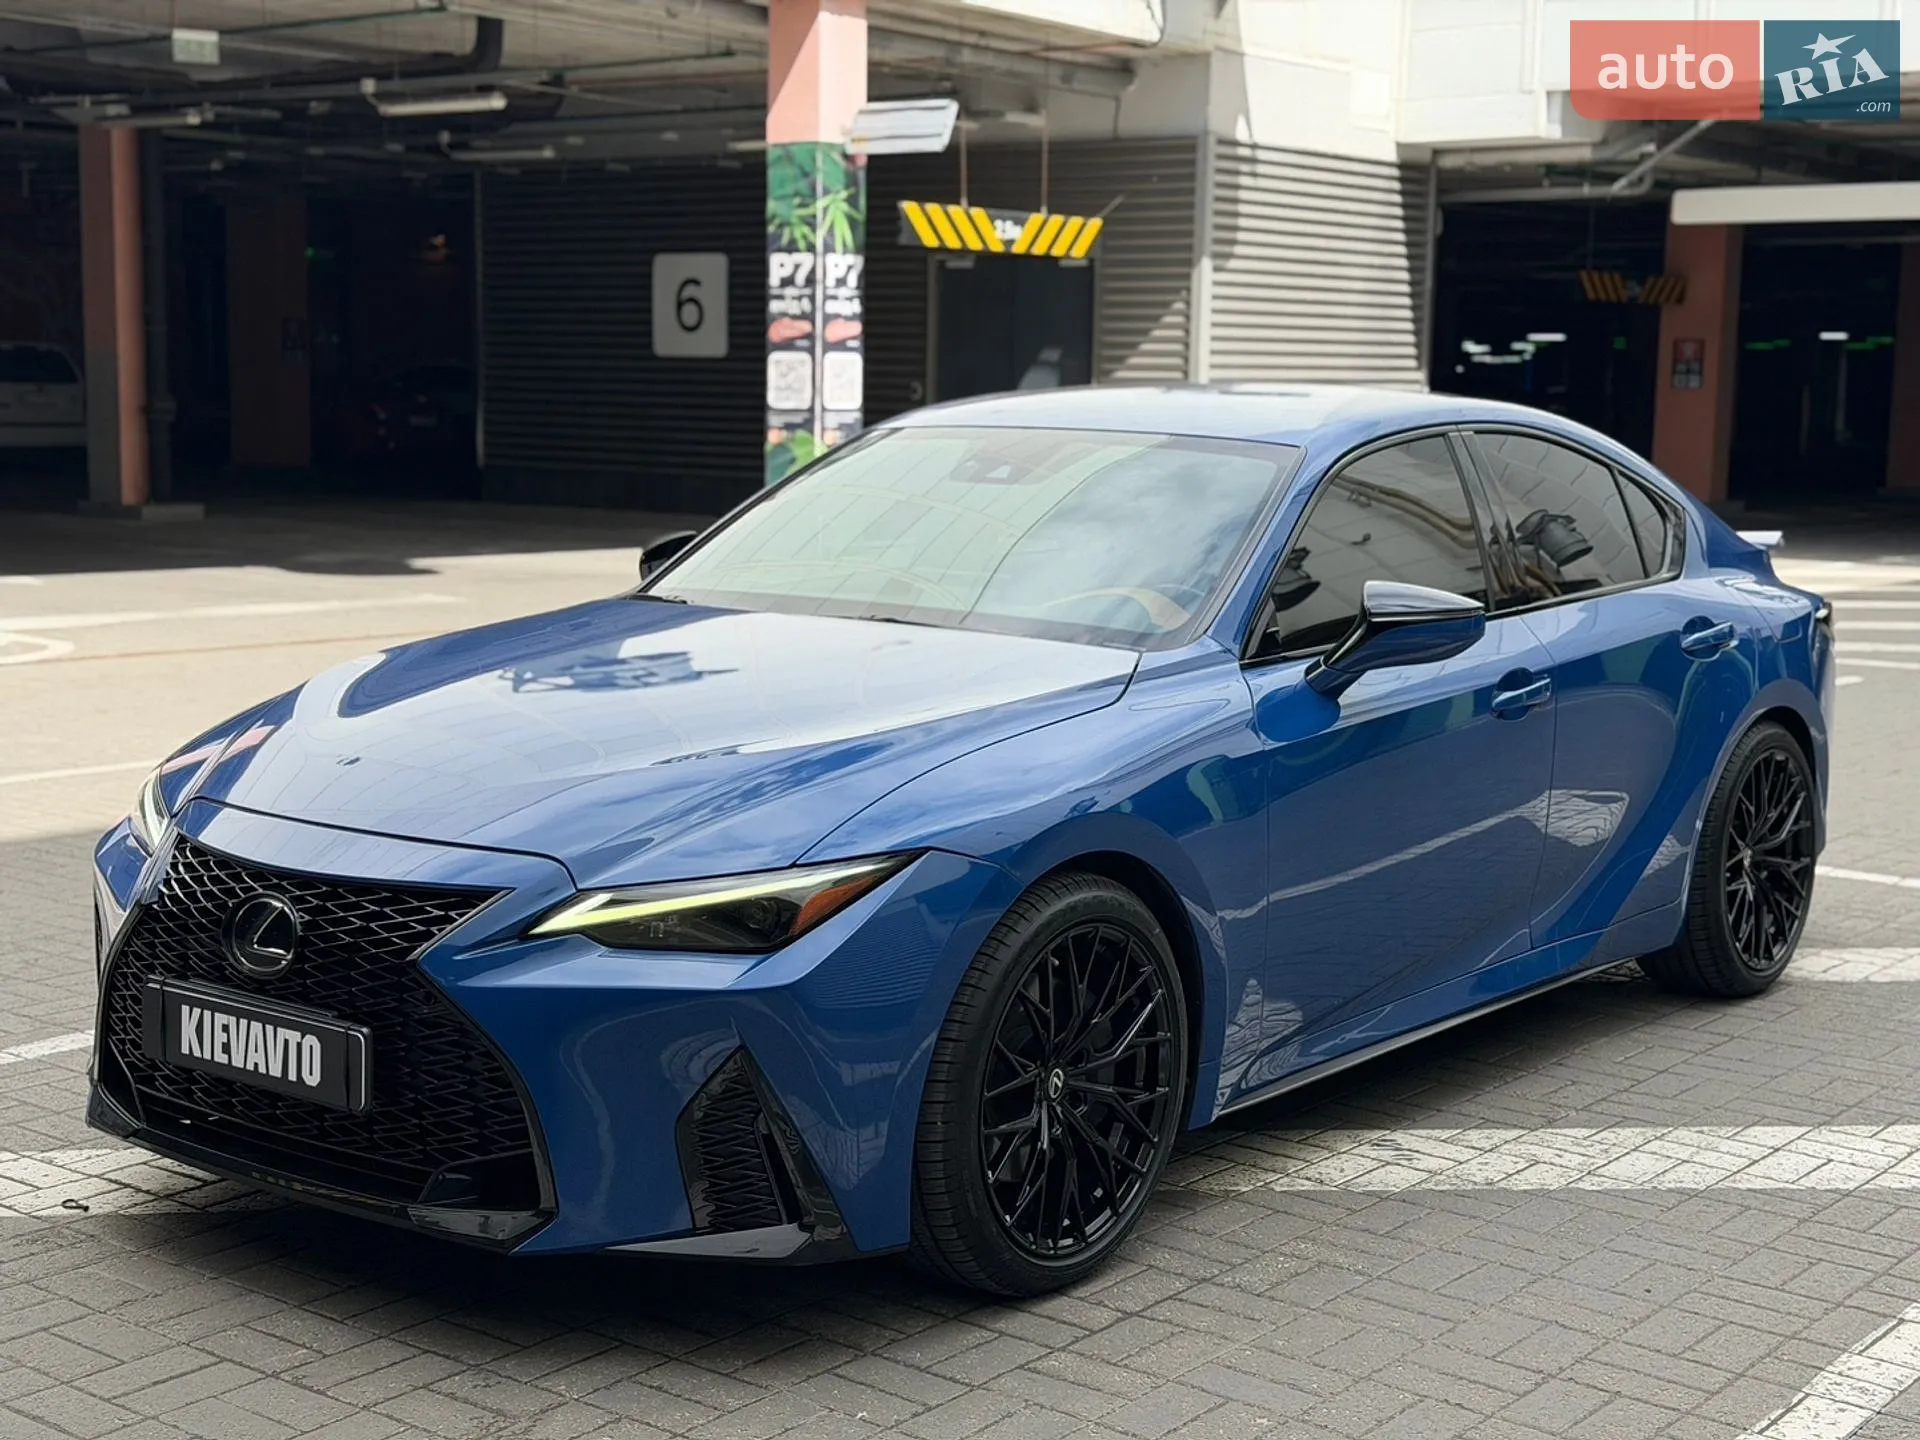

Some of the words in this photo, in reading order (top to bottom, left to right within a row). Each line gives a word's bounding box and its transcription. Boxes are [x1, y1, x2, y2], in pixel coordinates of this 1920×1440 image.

[768, 252, 815, 288] P7
[824, 253, 864, 289] P7
[676, 278, 704, 333] 6
[181, 1004, 321, 1088] KIEVAVTO
